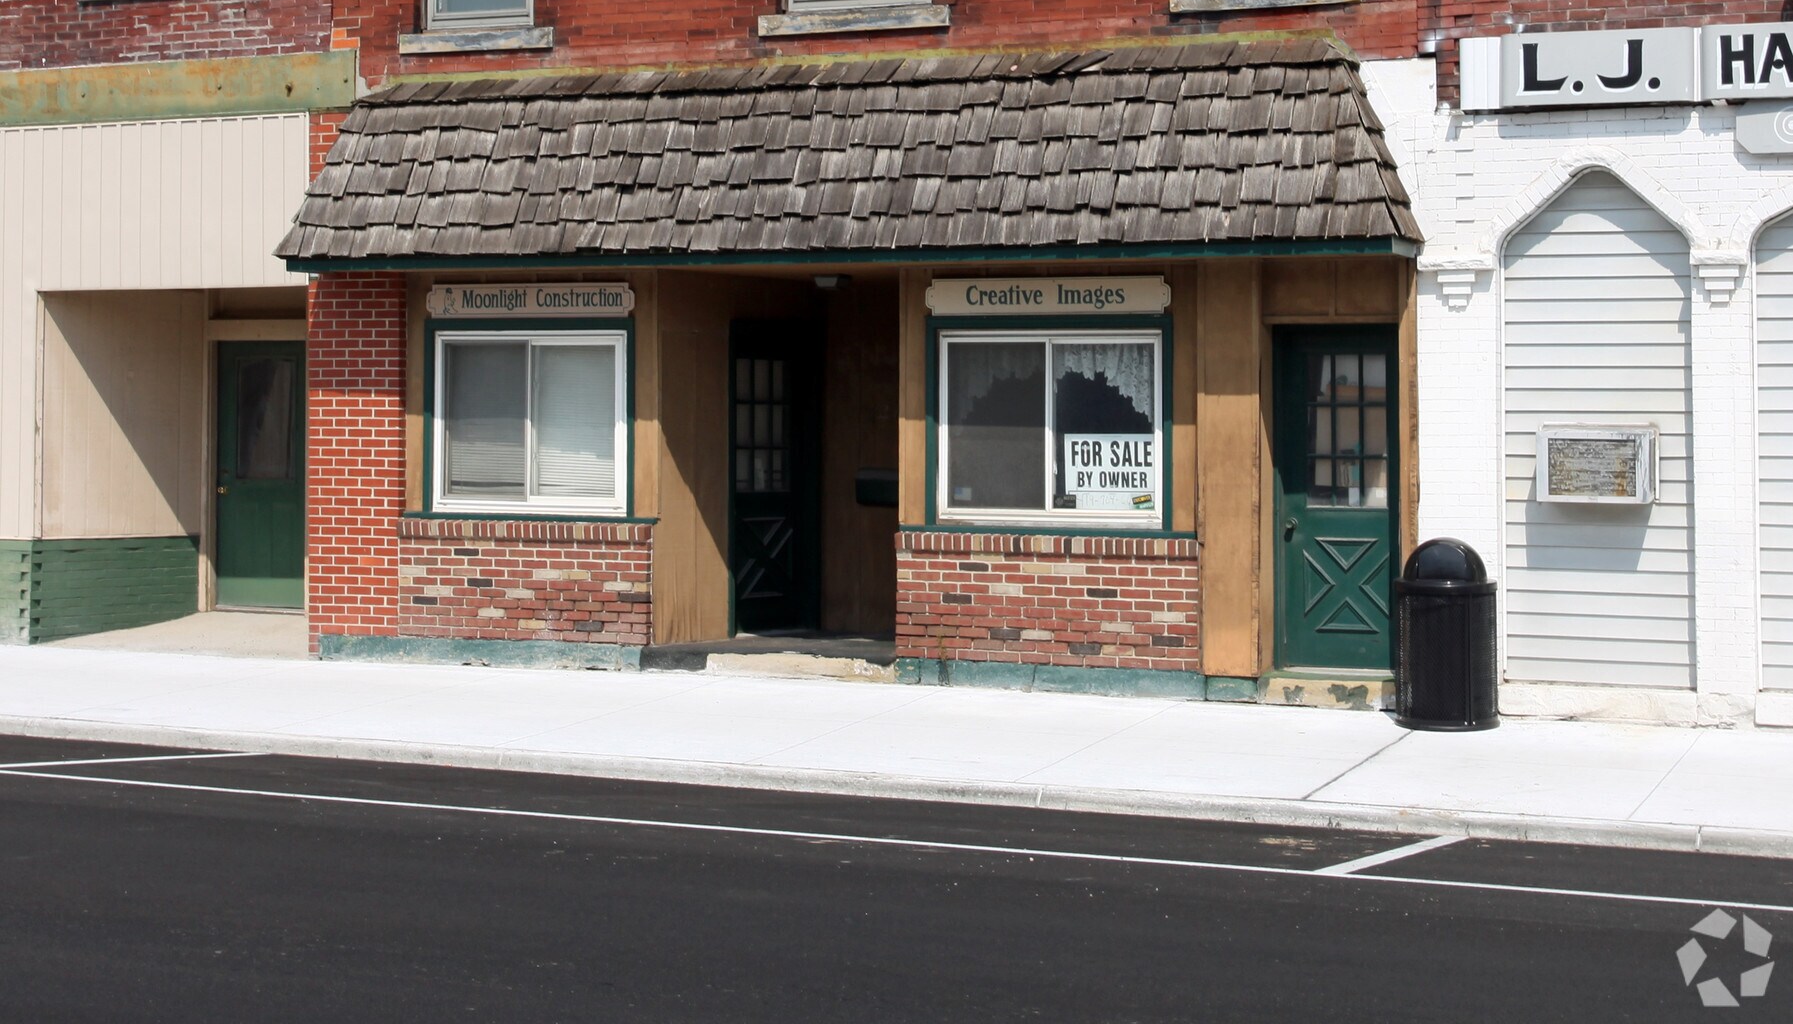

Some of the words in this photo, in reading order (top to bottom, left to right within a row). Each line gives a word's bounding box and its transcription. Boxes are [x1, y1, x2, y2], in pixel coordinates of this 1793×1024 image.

[461, 289, 527, 311] Moonlight
[536, 288, 623, 307] Construction
[966, 284, 1043, 305] Creative
[1057, 284, 1126, 309] Images
[1071, 440, 1103, 467] FOR
[1110, 440, 1153, 467] SALE
[1077, 471, 1093, 488] BY
[1099, 471, 1148, 488] OWNER
